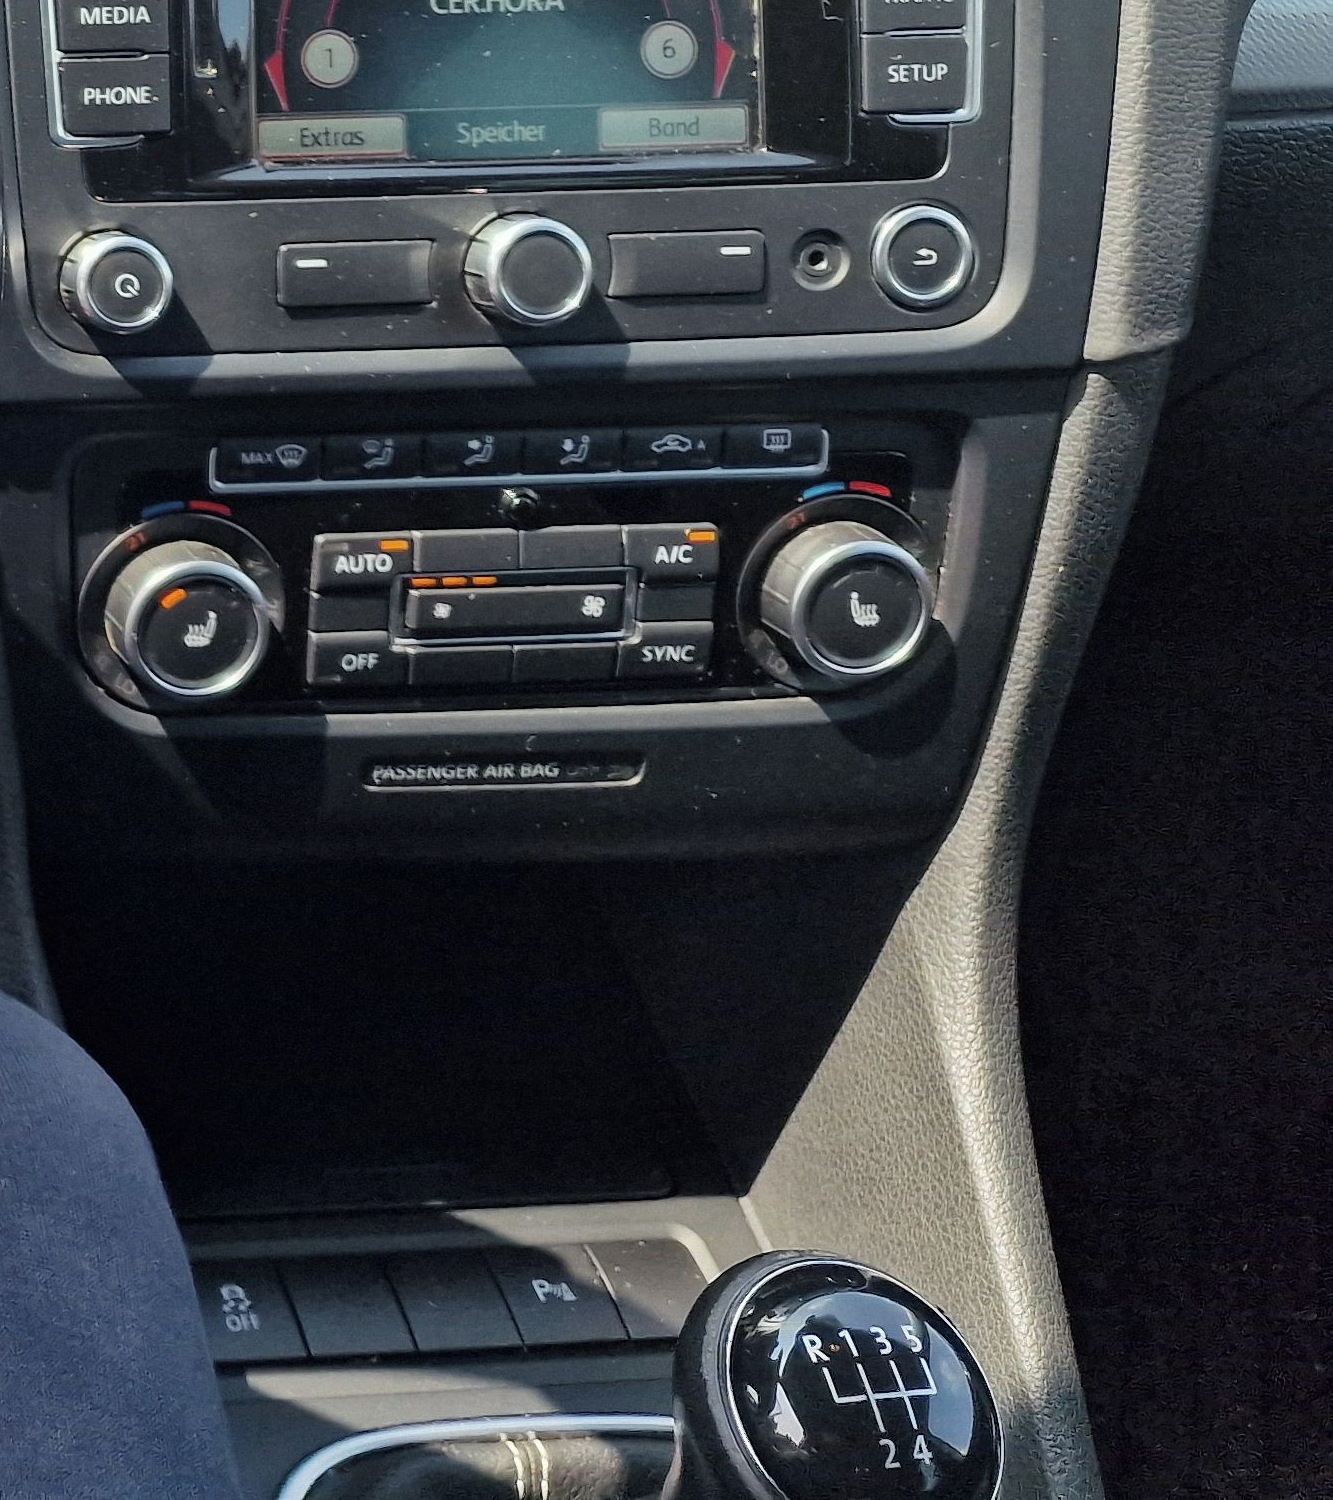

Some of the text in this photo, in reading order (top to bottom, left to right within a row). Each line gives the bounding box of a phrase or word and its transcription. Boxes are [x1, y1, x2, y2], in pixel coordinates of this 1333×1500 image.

[79, 6, 151, 26] MEDIA
[325, 48, 334, 69] 1
[662, 38, 675, 59] 6
[888, 63, 948, 83] SETUP
[83, 85, 151, 106] PHONE
[300, 128, 365, 148] Extras
[457, 122, 545, 148] Speicher
[649, 118, 700, 138] Band
[241, 452, 272, 465] MAX
[335, 554, 393, 574] AUTO
[655, 545, 693, 564] A/C
[341, 653, 379, 671] OFF
[642, 645, 696, 663] SYNC
[373, 764, 479, 781] PASSENGER
[483, 763, 515, 779] AIR
[520, 762, 560, 778] BAG
[802, 1325, 923, 1364] R 1 3 5
[879, 1434, 933, 1469] 2 4
